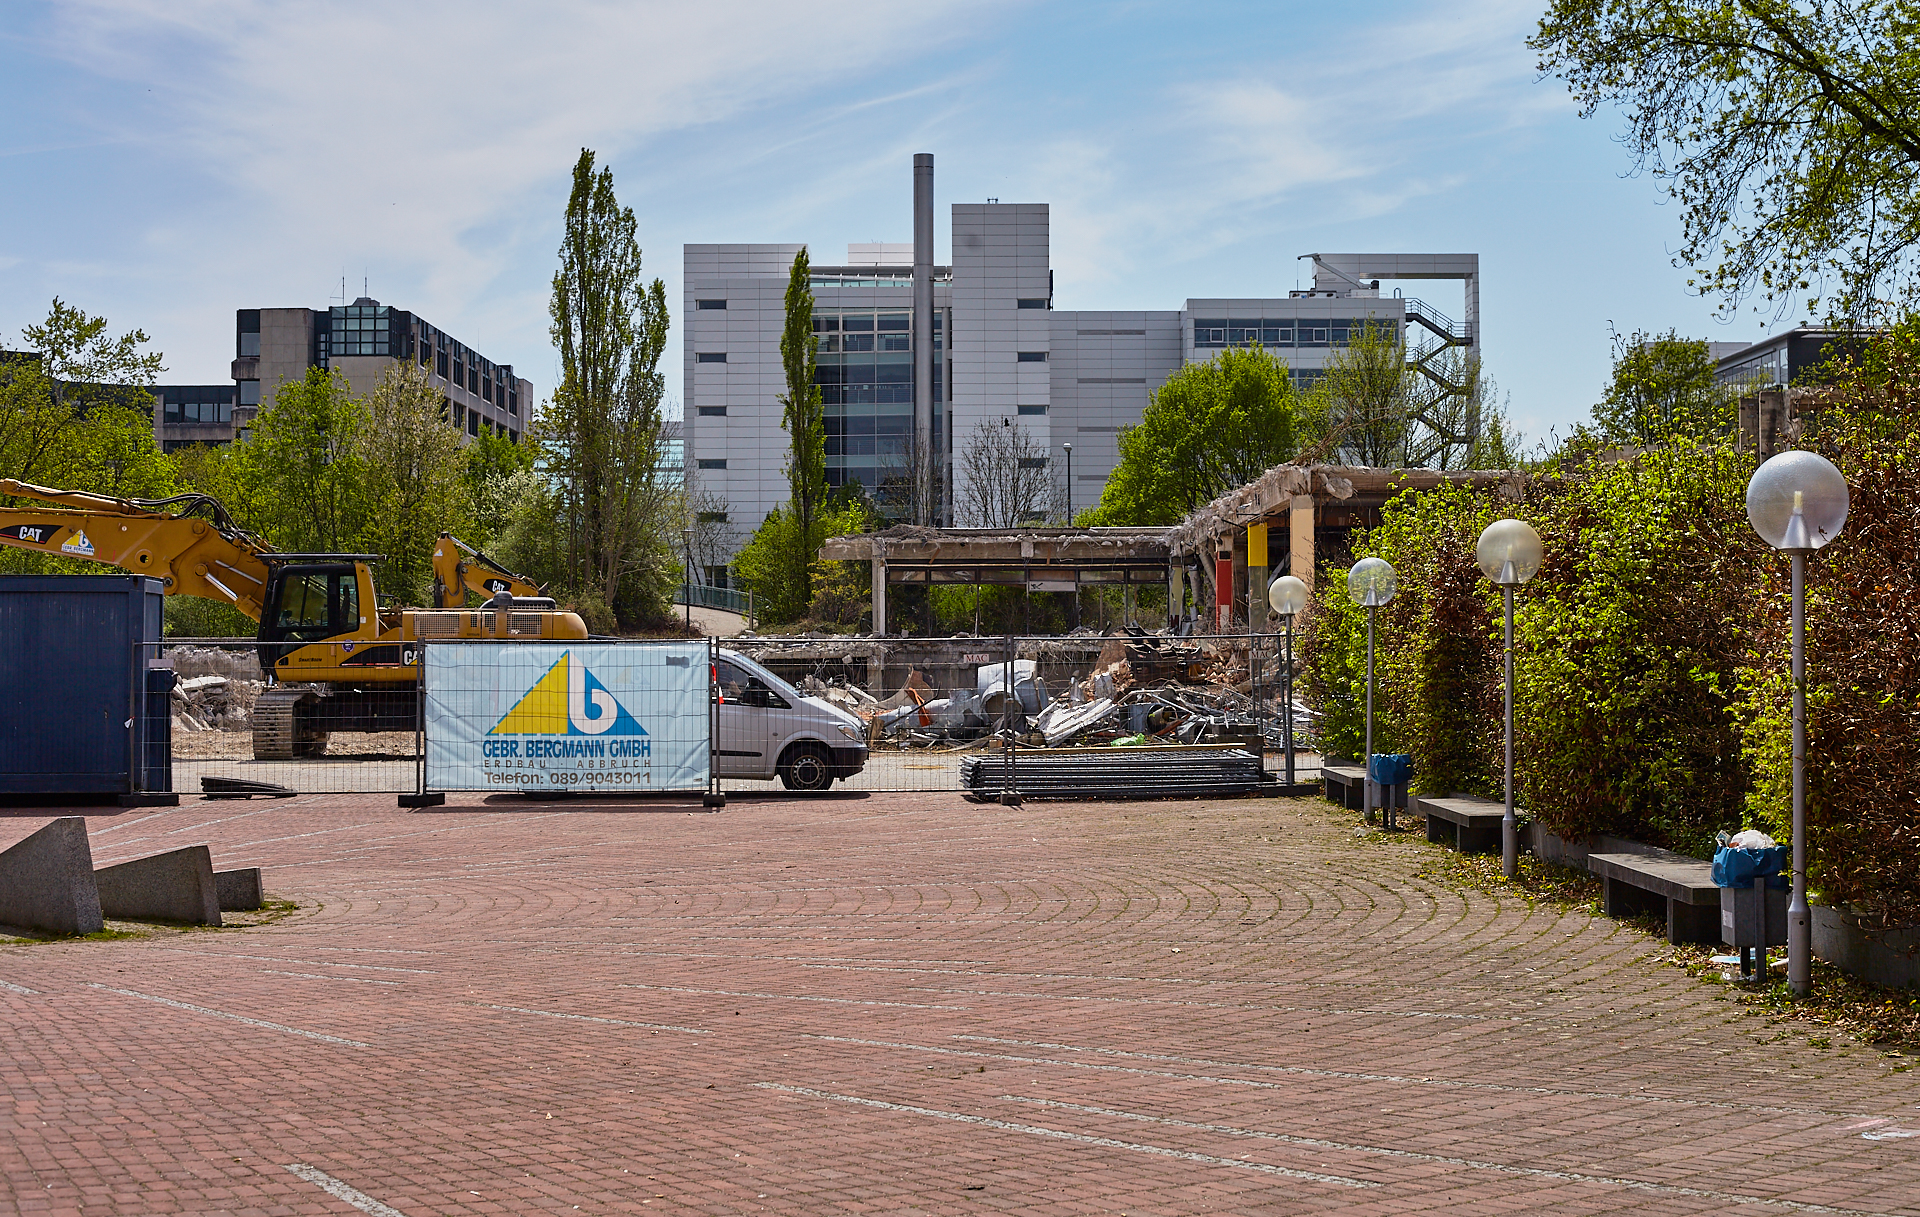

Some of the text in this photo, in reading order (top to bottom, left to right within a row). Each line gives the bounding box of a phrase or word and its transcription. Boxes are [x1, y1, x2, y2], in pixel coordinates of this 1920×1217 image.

[19, 526, 43, 542] CAT
[492, 580, 505, 592] CAT
[966, 654, 988, 662] MAC
[1251, 651, 1271, 659] MAC
[483, 740, 651, 758] GEBR. BERGMANN GMBH
[484, 760, 651, 768] ERDBAU ABBRUCH
[484, 772, 651, 785] Telefon: 089/9043011
